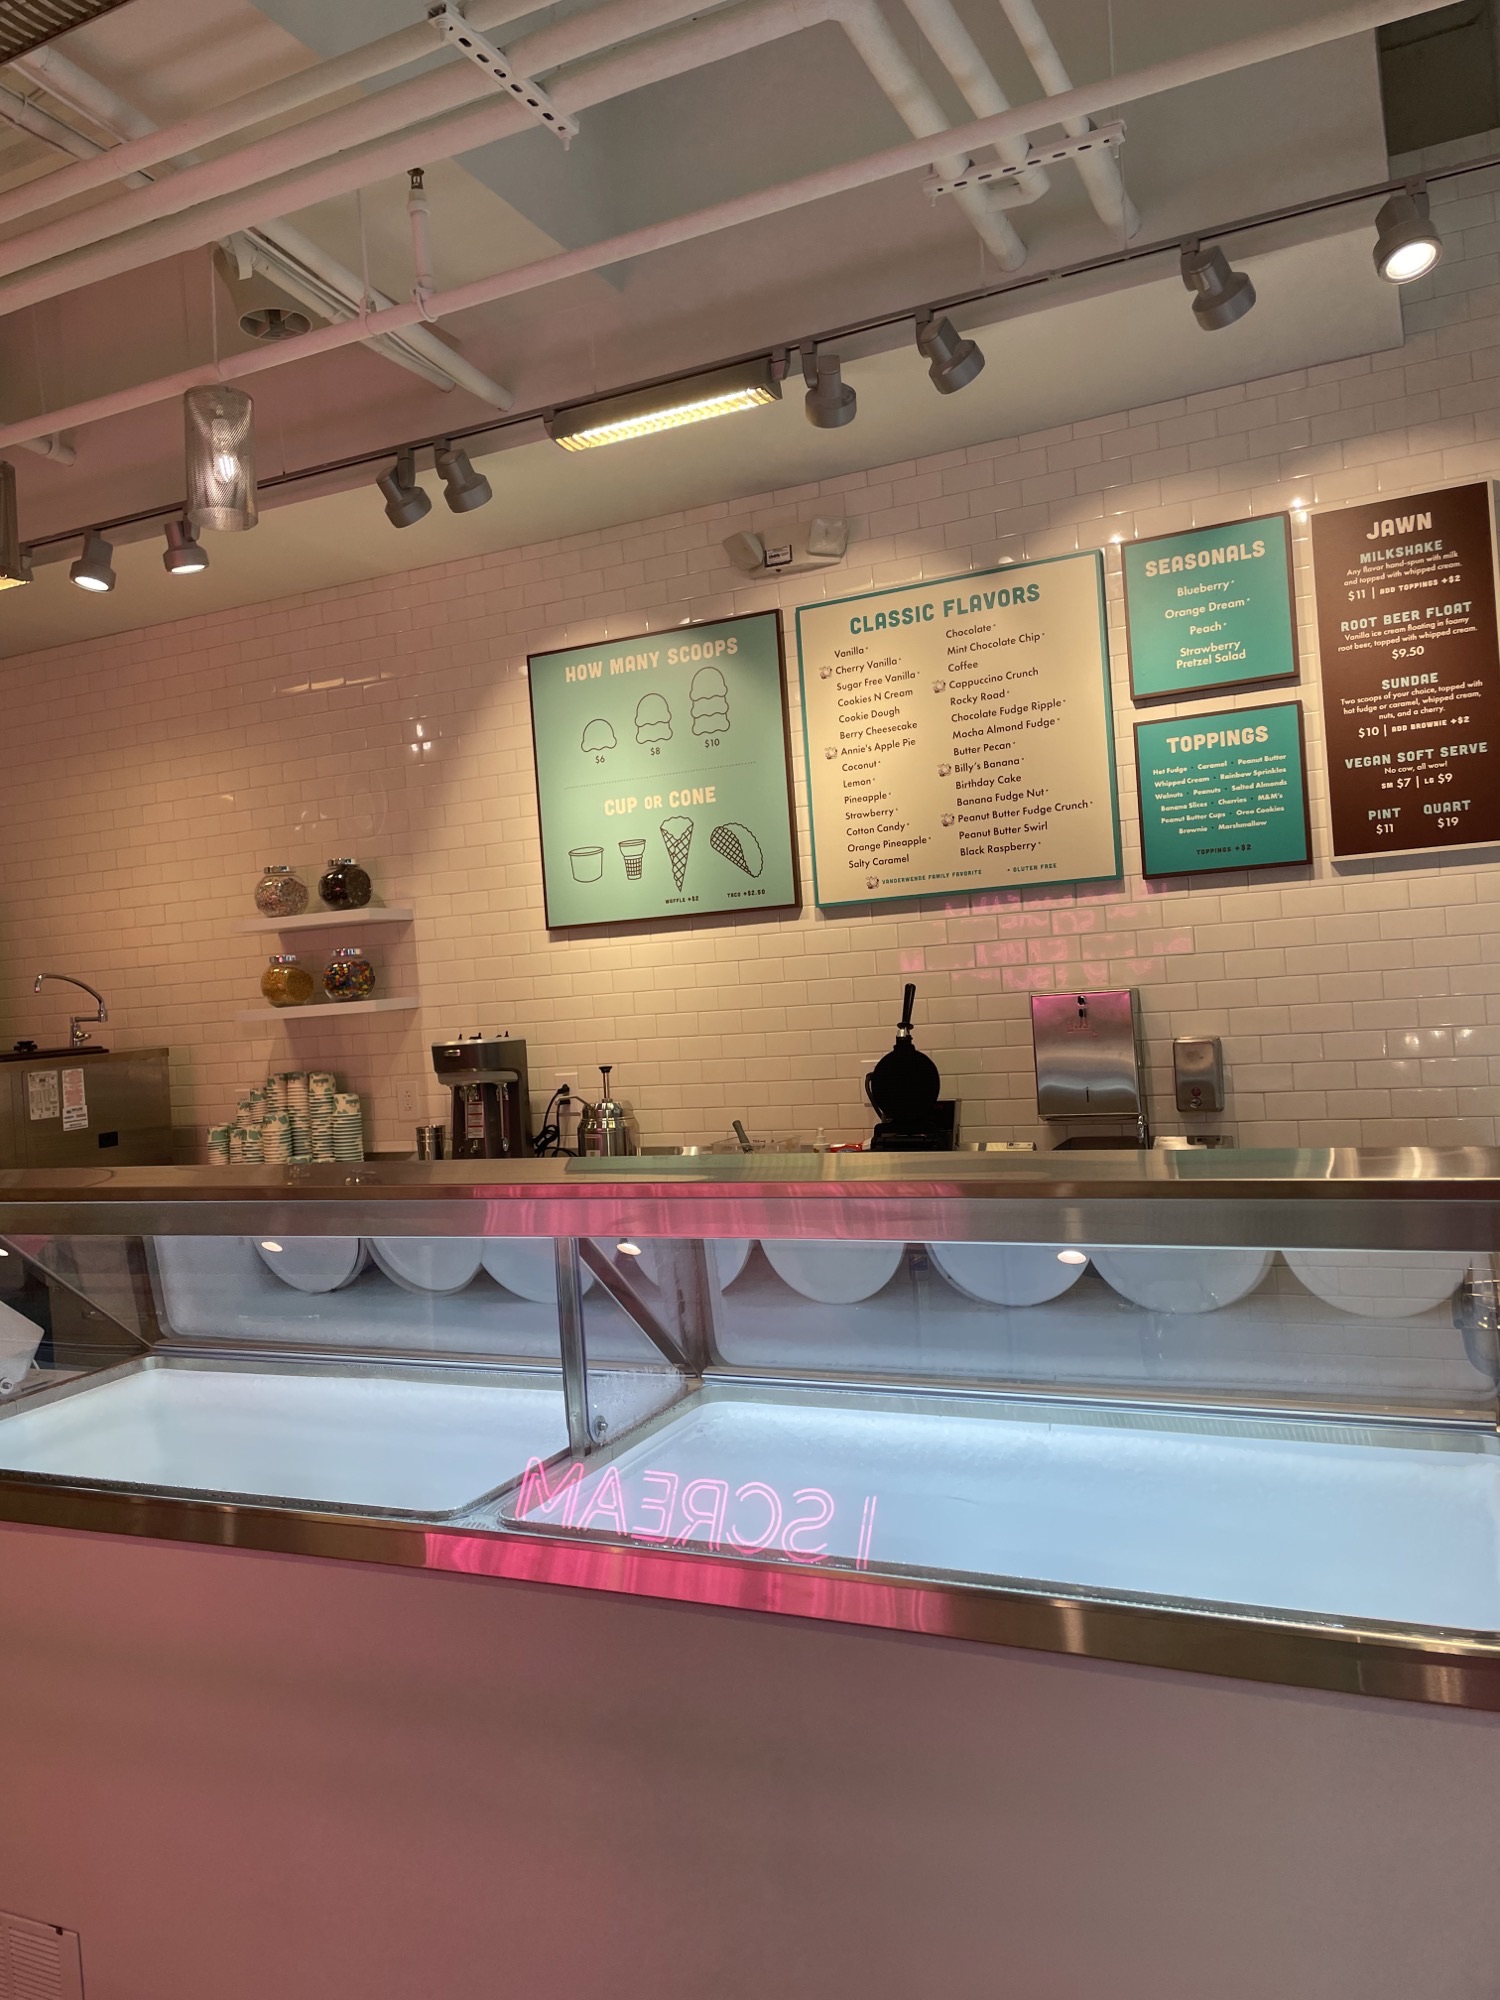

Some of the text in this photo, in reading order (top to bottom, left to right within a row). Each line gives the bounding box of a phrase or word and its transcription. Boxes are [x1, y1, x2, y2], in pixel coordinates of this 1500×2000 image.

[1366, 512, 1432, 540] JAWN
[1146, 540, 1265, 577] SEASONALS
[1360, 540, 1443, 564] MILKSHAKE
[1363, 565, 1384, 573] flavor
[1386, 558, 1425, 569] hand-spun
[1426, 554, 1442, 562] with
[1443, 550, 1458, 559] milk
[1177, 582, 1229, 597] Blueberry
[1348, 575, 1461, 602] $11 ADD TOPPINGS +$2
[850, 584, 1040, 635] CLASSIC FLAVORS
[1165, 600, 1245, 619] Orange Dream
[1341, 601, 1472, 632] ROOT BEER FLOAT
[946, 625, 992, 638] Chocolate
[1190, 621, 1222, 635] Peach
[1345, 631, 1370, 641] Vanilla
[1408, 623, 1436, 631] floating
[1445, 617, 1469, 625] foamy
[834, 646, 864, 658] Vanilla
[947, 633, 1040, 655] Mint Chocolate Chip
[1180, 641, 1241, 657] Strawberry
[566, 638, 738, 683] HOW MANY SCOOPS
[1177, 650, 1246, 669] Pretzel Salad
[1392, 646, 1424, 660] $9.50
[836, 657, 897, 675] Cherry Vanilla
[948, 661, 978, 672] Coffee
[837, 670, 916, 691] Sugar Free Vanilla
[949, 667, 1039, 689] Cappuccino Crunch
[1382, 672, 1438, 690] SUNDAE
[838, 690, 913, 707] Cookies N Cream
[950, 689, 1005, 706] Rocky Road
[839, 706, 900, 723] Cookie Dough
[951, 698, 1062, 722] Chocolate Fudge Ripple
[1397, 709, 1411, 717] and
[840, 721, 917, 740] Berry Cheesecake
[953, 718, 1055, 739] Mocha Almond Fudge
[1359, 727, 1379, 738] $10
[1411, 720, 1447, 730] BROWNIE
[1450, 716, 1470, 724] +$2
[705, 738, 720, 748] $10
[841, 738, 916, 755] Annie's Apple Pie
[1166, 726, 1268, 753] TOPPINGS
[651, 747, 661, 756] $8
[954, 743, 1011, 756] Butter Pecan
[1345, 742, 1488, 769] VEGAN SOFT SERVE
[596, 755, 605, 764] $6
[842, 761, 877, 772] Coconut
[955, 759, 1020, 773] Billy's Banana
[1167, 766, 1187, 774] Fudge
[1197, 760, 1227, 770] Caramel
[1238, 757, 1263, 765] Peanut
[1427, 760, 1448, 768] wow!
[843, 779, 871, 788] Lemon
[956, 774, 1021, 790] Birthday Cake
[1154, 778, 1186, 787] Whipped
[1220, 772, 1252, 780] Rainbow
[1253, 767, 1287, 777] Sprinkles
[1232, 783, 1254, 791] Salted
[1256, 779, 1287, 788] Almonds
[1397, 778, 1411, 789] $7
[1438, 773, 1453, 784] $9
[605, 786, 716, 816] CUP OR CONE
[844, 791, 887, 804] Pineapple
[957, 789, 1044, 806] Banana Fudge Nut
[845, 809, 894, 820] Strawberry
[958, 800, 1088, 823] Peanut Butter Fudge Crunch
[1368, 800, 1471, 820] PINT QUART
[846, 822, 905, 836] Cotton Candy
[959, 821, 1048, 840] Peanut Butter Swirl
[1376, 817, 1459, 835] $11 $19
[847, 836, 927, 852] Orange Pineapple
[960, 842, 1036, 856] Black Raspberry
[1196, 847, 1232, 855] TOPPINGS
[849, 854, 909, 869] Salty Caramel
